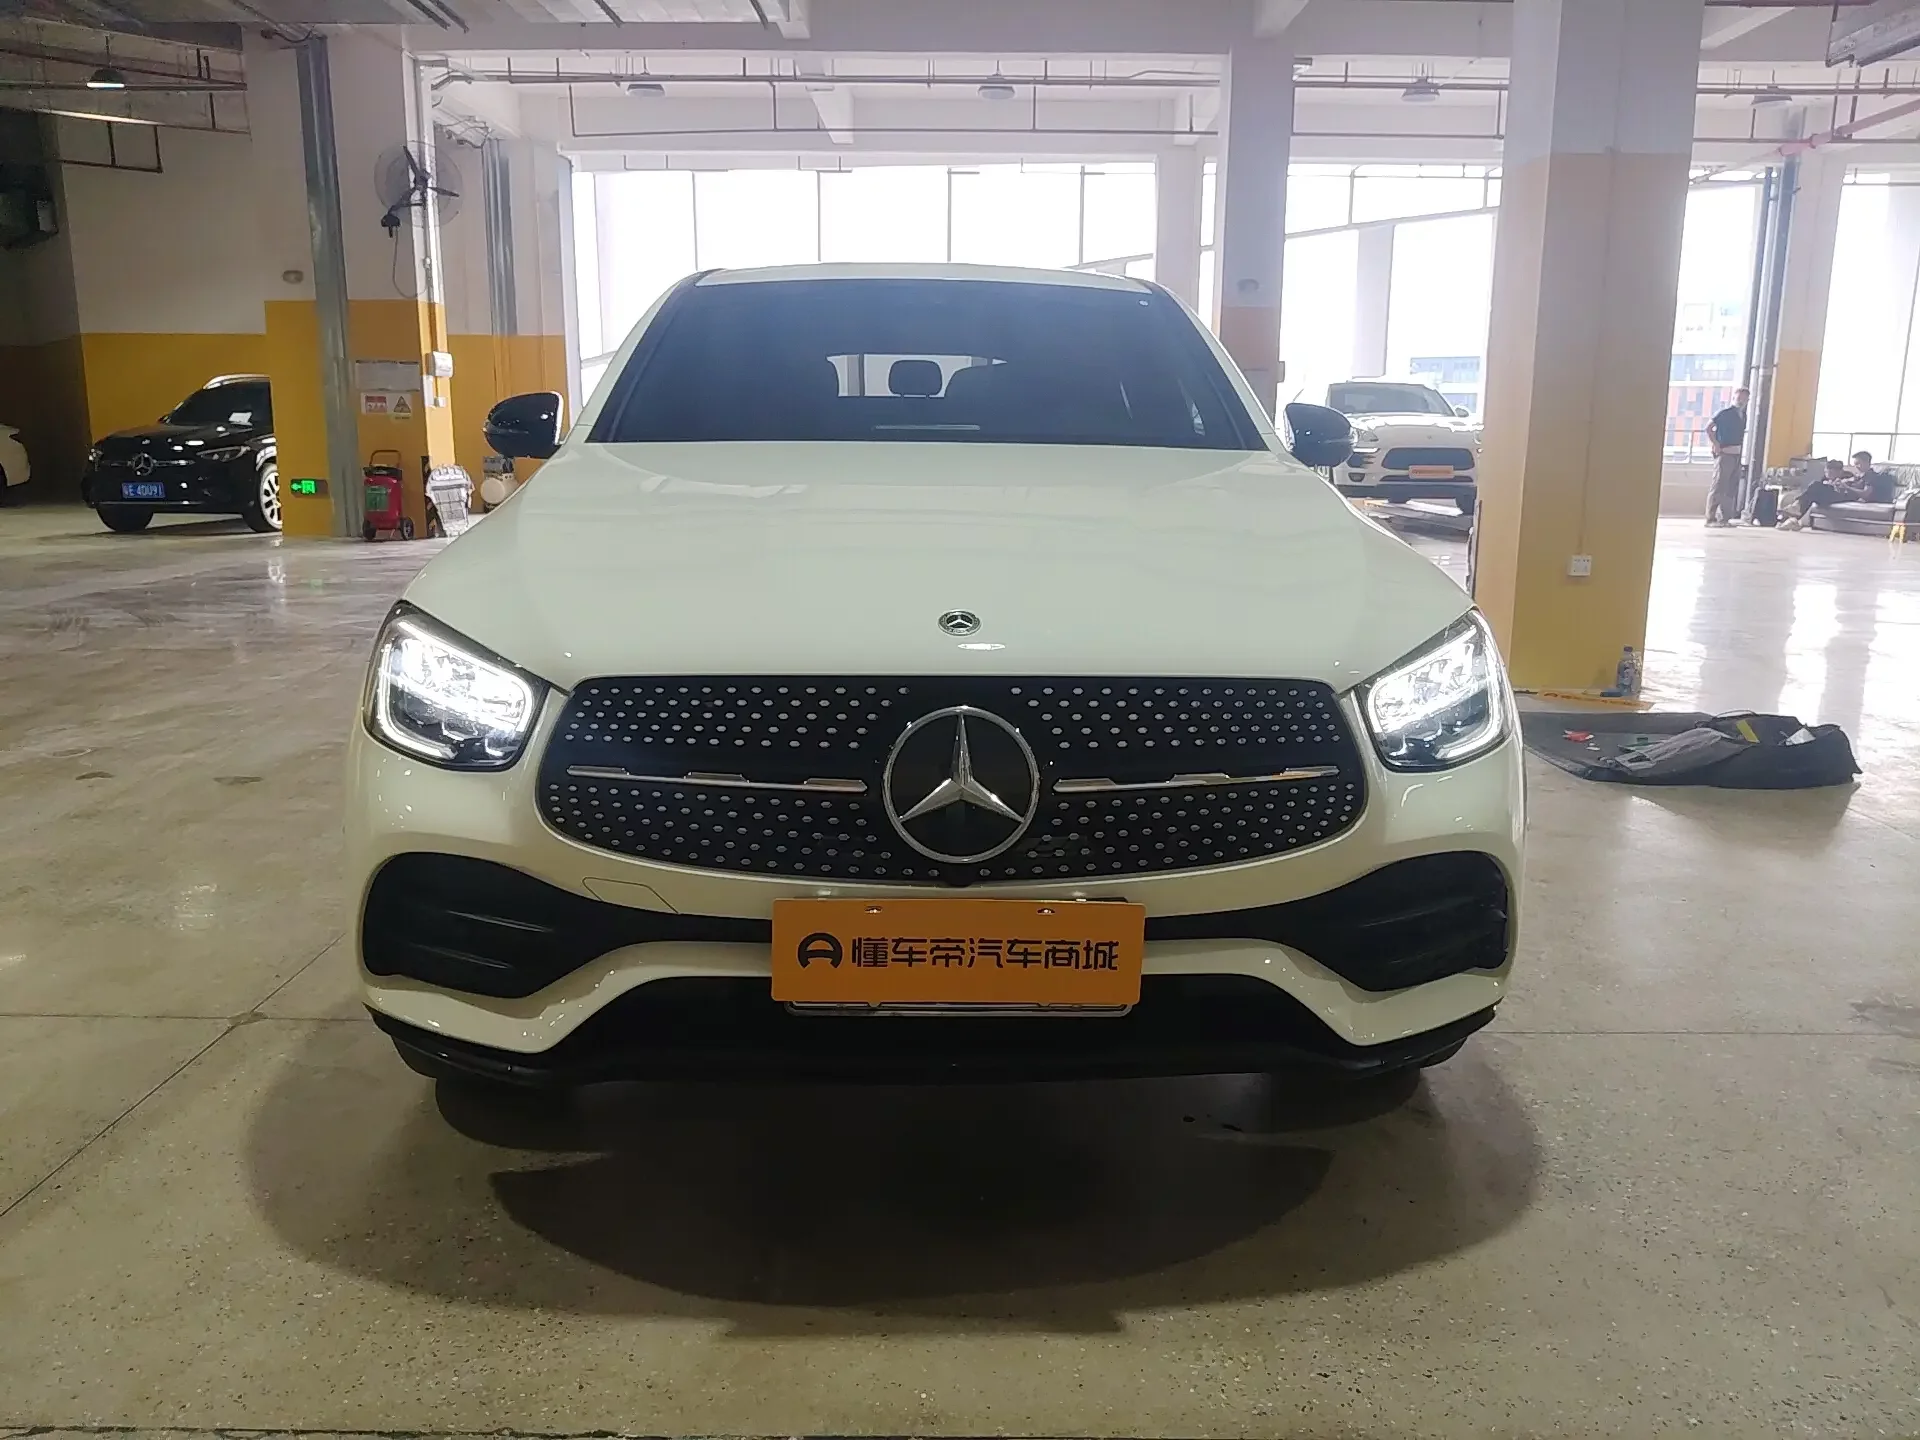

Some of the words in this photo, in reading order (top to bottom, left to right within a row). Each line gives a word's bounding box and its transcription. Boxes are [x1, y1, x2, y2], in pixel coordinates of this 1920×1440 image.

[851, 936, 1119, 970] 懂车帝汽车商城
